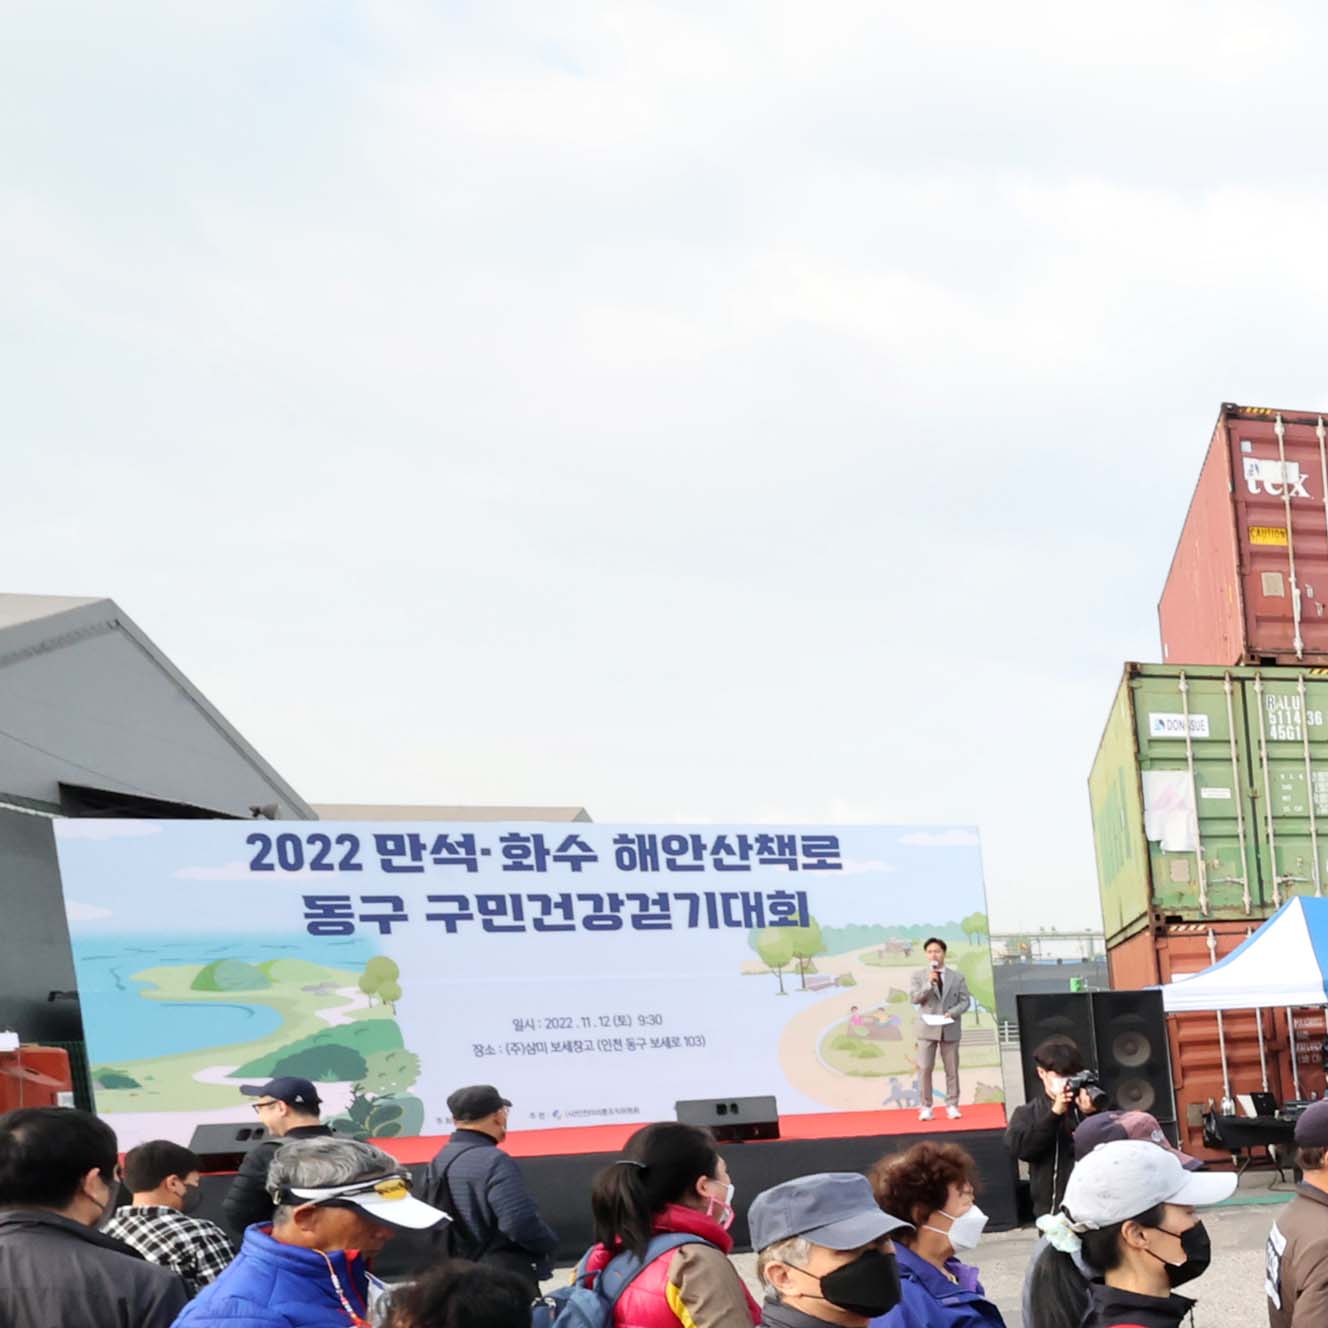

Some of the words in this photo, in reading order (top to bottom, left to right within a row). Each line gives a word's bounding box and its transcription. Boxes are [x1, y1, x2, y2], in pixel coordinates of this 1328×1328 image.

[1266, 695, 1301, 710] RALU
[1167, 719, 1206, 732] DONSUE
[246, 832, 363, 872] 2022
[613, 833, 843, 872] 해안산책로
[302, 895, 408, 936] 동구
[426, 890, 811, 933] 구민건강걷기대회
[512, 1018, 536, 1032] 일시
[638, 1014, 663, 1026] 9:30
[472, 1043, 496, 1058] 장소
[683, 1034, 706, 1048] 103)
